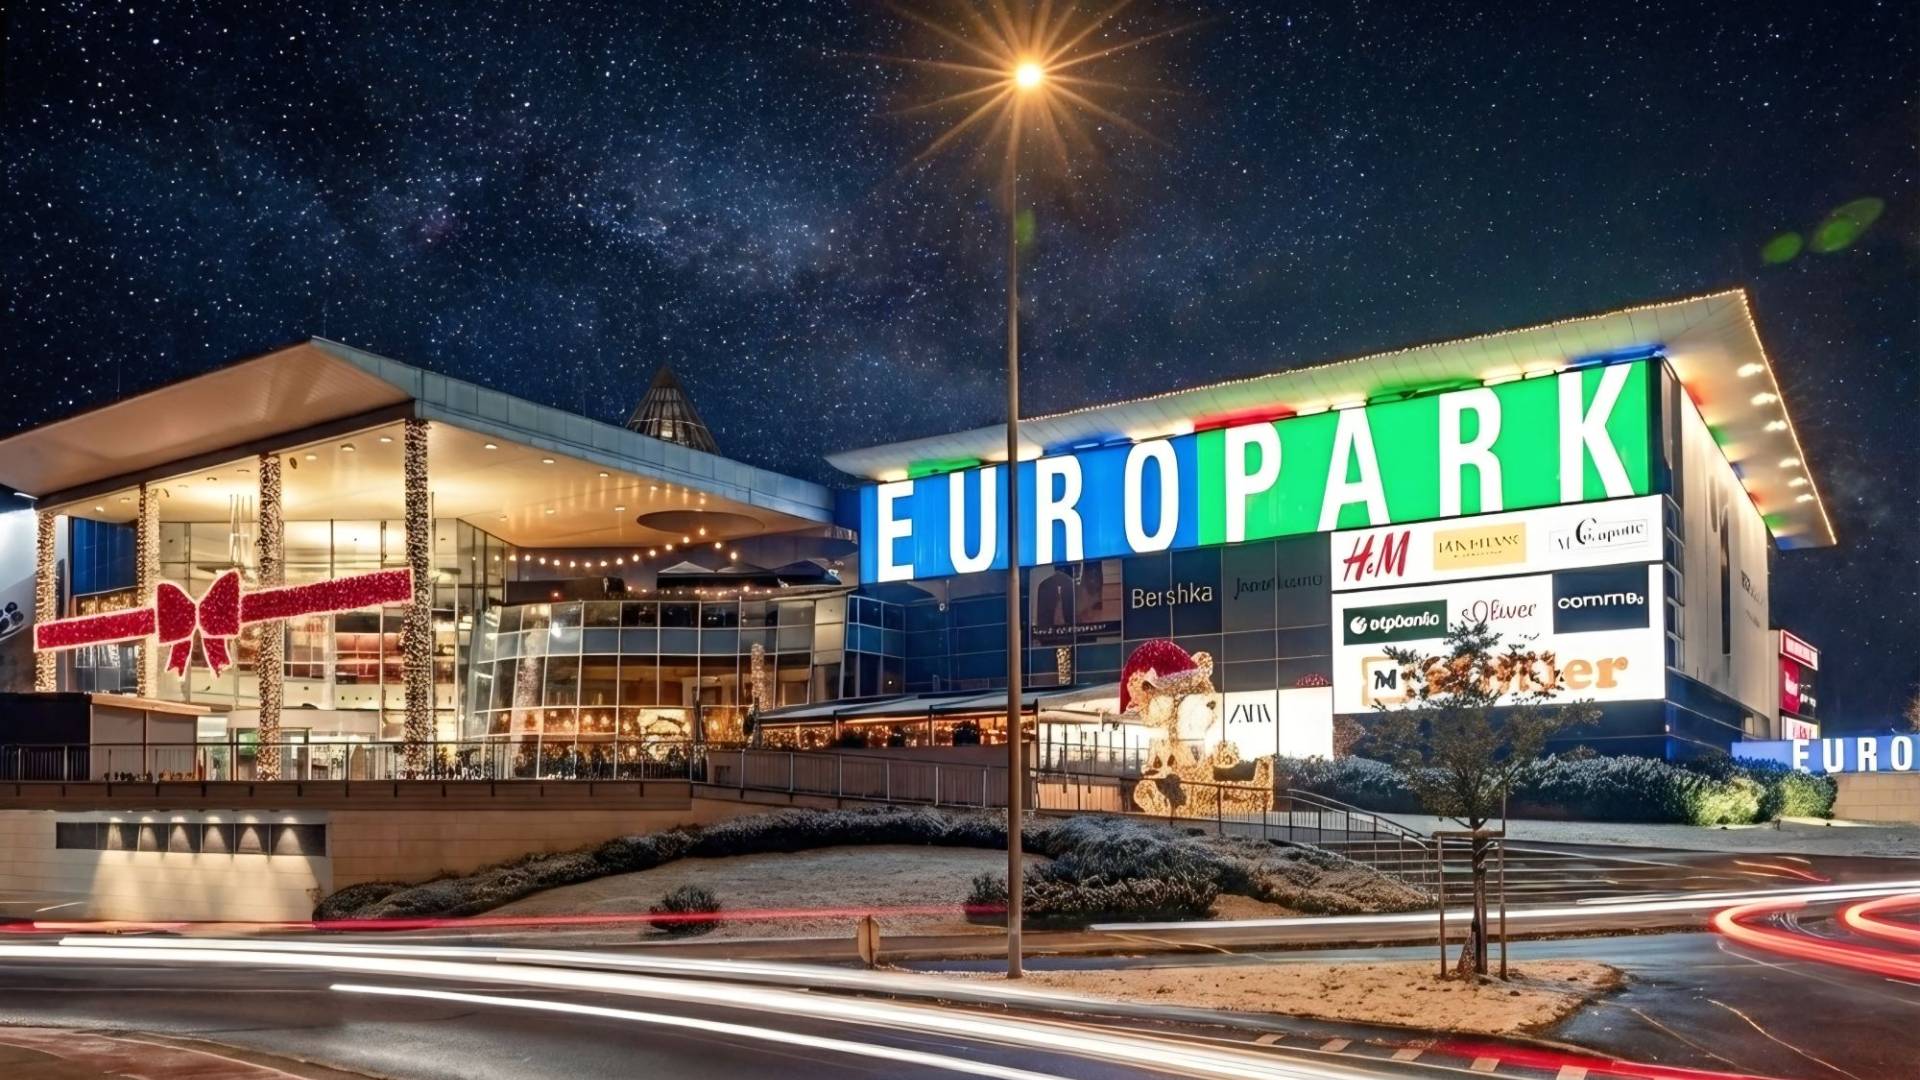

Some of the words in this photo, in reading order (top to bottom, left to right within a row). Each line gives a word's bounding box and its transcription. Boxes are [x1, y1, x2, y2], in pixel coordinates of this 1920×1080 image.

[876, 363, 1637, 581] EUROPARK
[1131, 582, 1213, 610] Bershka
[1792, 735, 1913, 773] EURO
